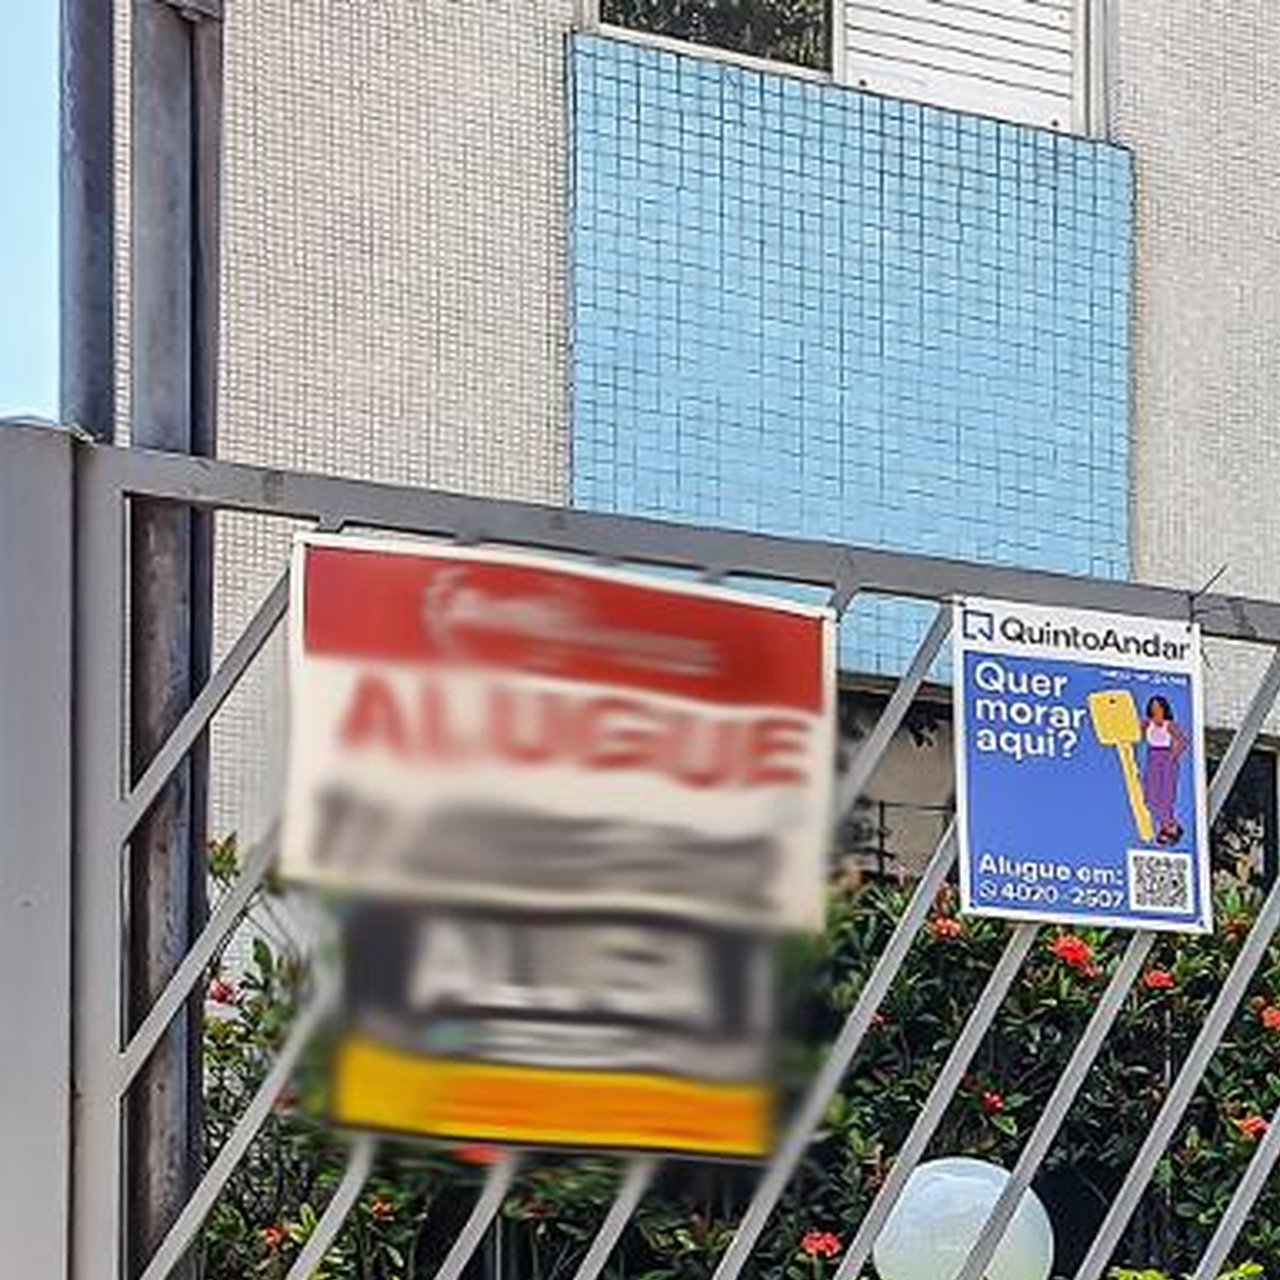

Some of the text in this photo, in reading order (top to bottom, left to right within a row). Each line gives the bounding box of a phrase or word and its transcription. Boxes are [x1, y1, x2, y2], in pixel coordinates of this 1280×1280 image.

[999, 616, 1191, 661] QuintoAndar
[974, 661, 1068, 698] Quer
[975, 698, 1087, 729] morar
[975, 728, 1079, 761] aqui?
[979, 853, 1072, 883] Alugue
